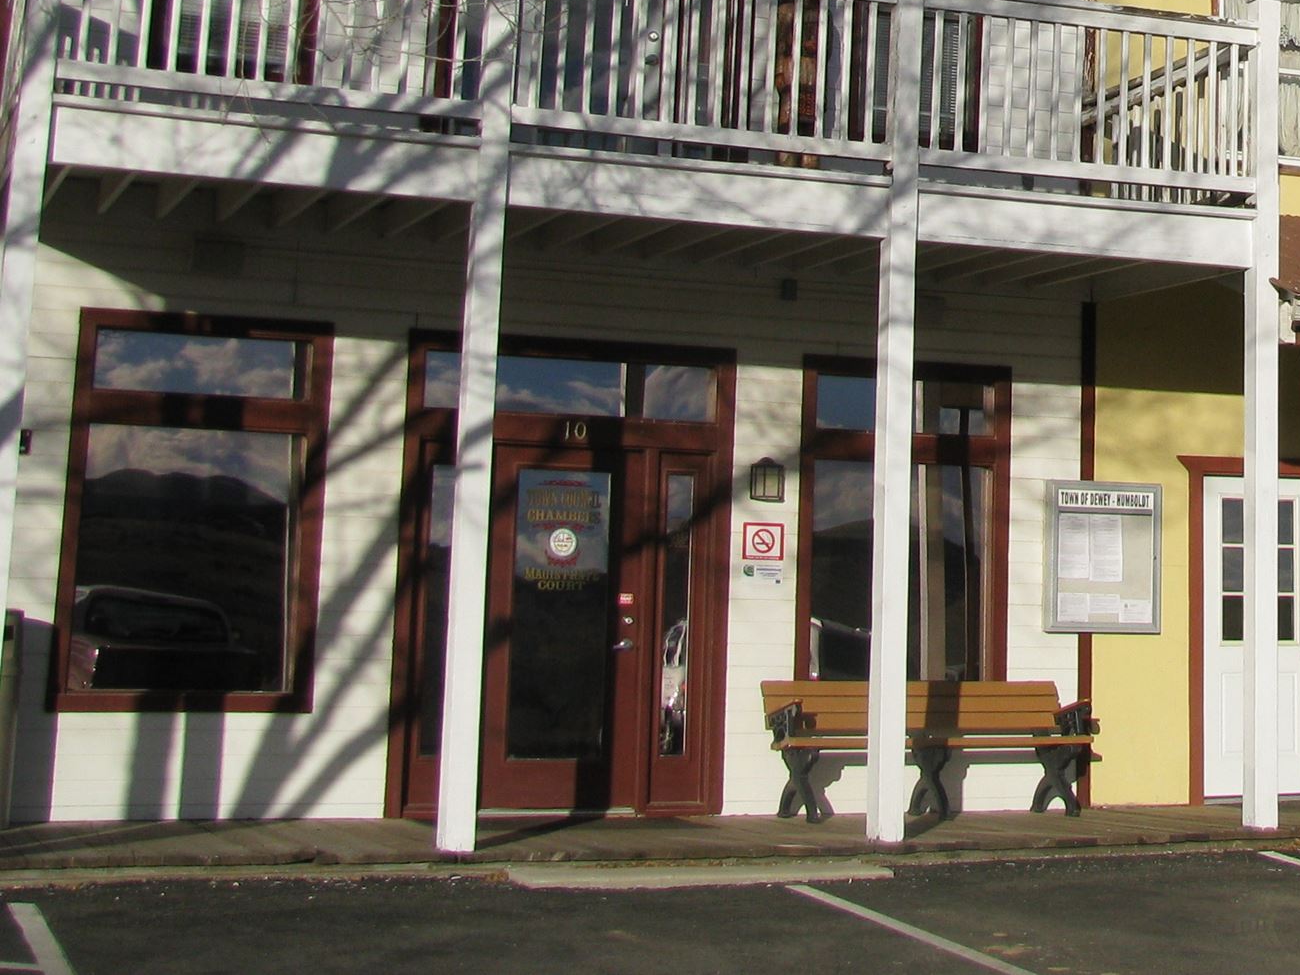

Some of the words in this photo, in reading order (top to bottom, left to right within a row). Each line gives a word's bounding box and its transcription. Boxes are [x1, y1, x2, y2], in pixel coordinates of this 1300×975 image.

[564, 421, 588, 441] 10
[1060, 491, 1079, 505] TOWN
[1081, 492, 1089, 505] OF
[1090, 493, 1111, 506] DEWEY
[1117, 494, 1150, 507] HUMBOLDT
[537, 580, 586, 591] COURT
